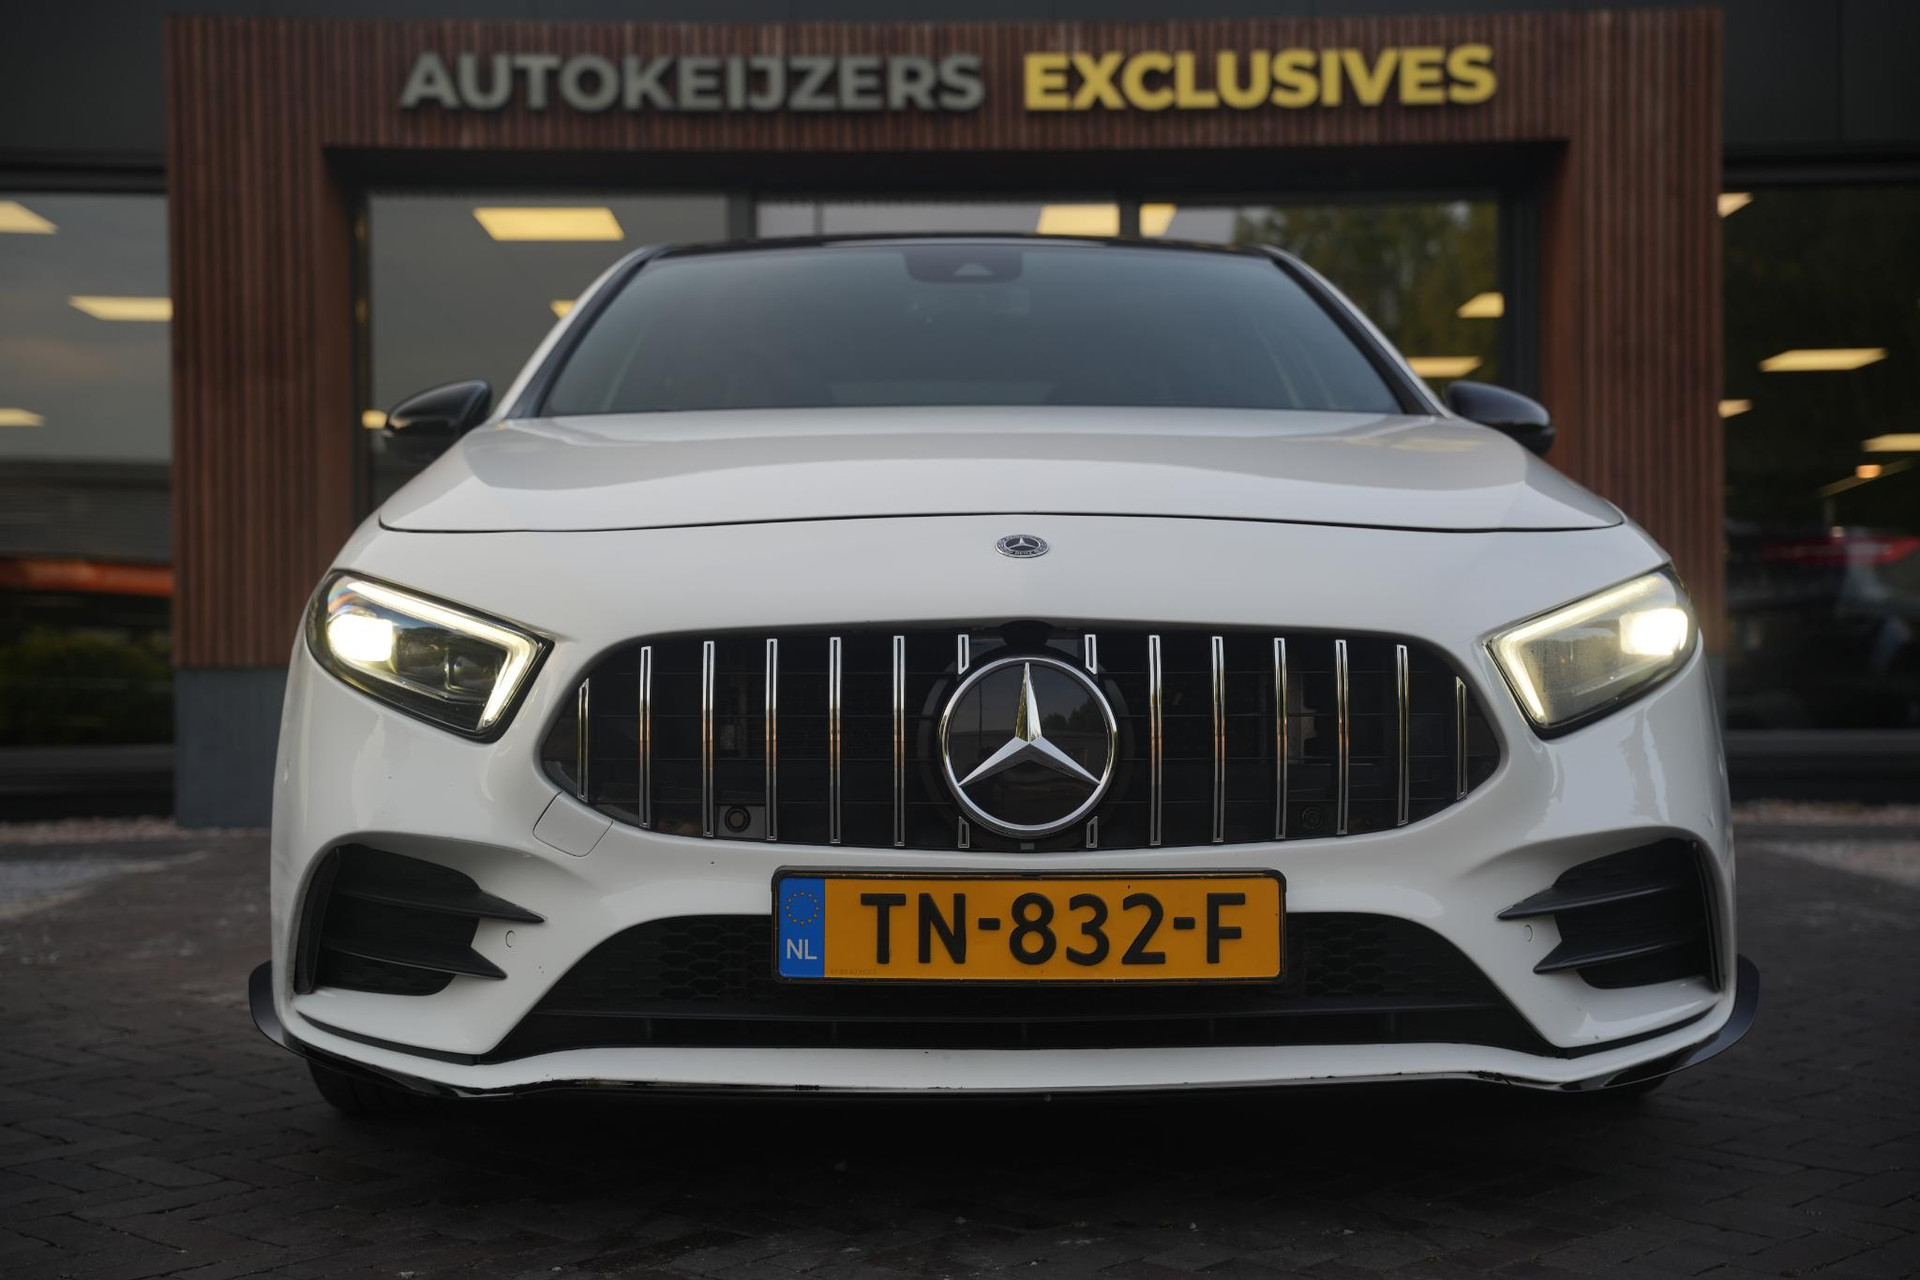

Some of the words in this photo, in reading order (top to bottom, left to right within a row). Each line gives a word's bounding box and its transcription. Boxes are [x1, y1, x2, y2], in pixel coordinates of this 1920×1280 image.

[401, 53, 985, 111] AUTOKEIJZERS
[1024, 44, 1497, 111] EXCLUSIVES
[786, 938, 817, 960] NL
[860, 892, 1246, 966] TN-832-F
